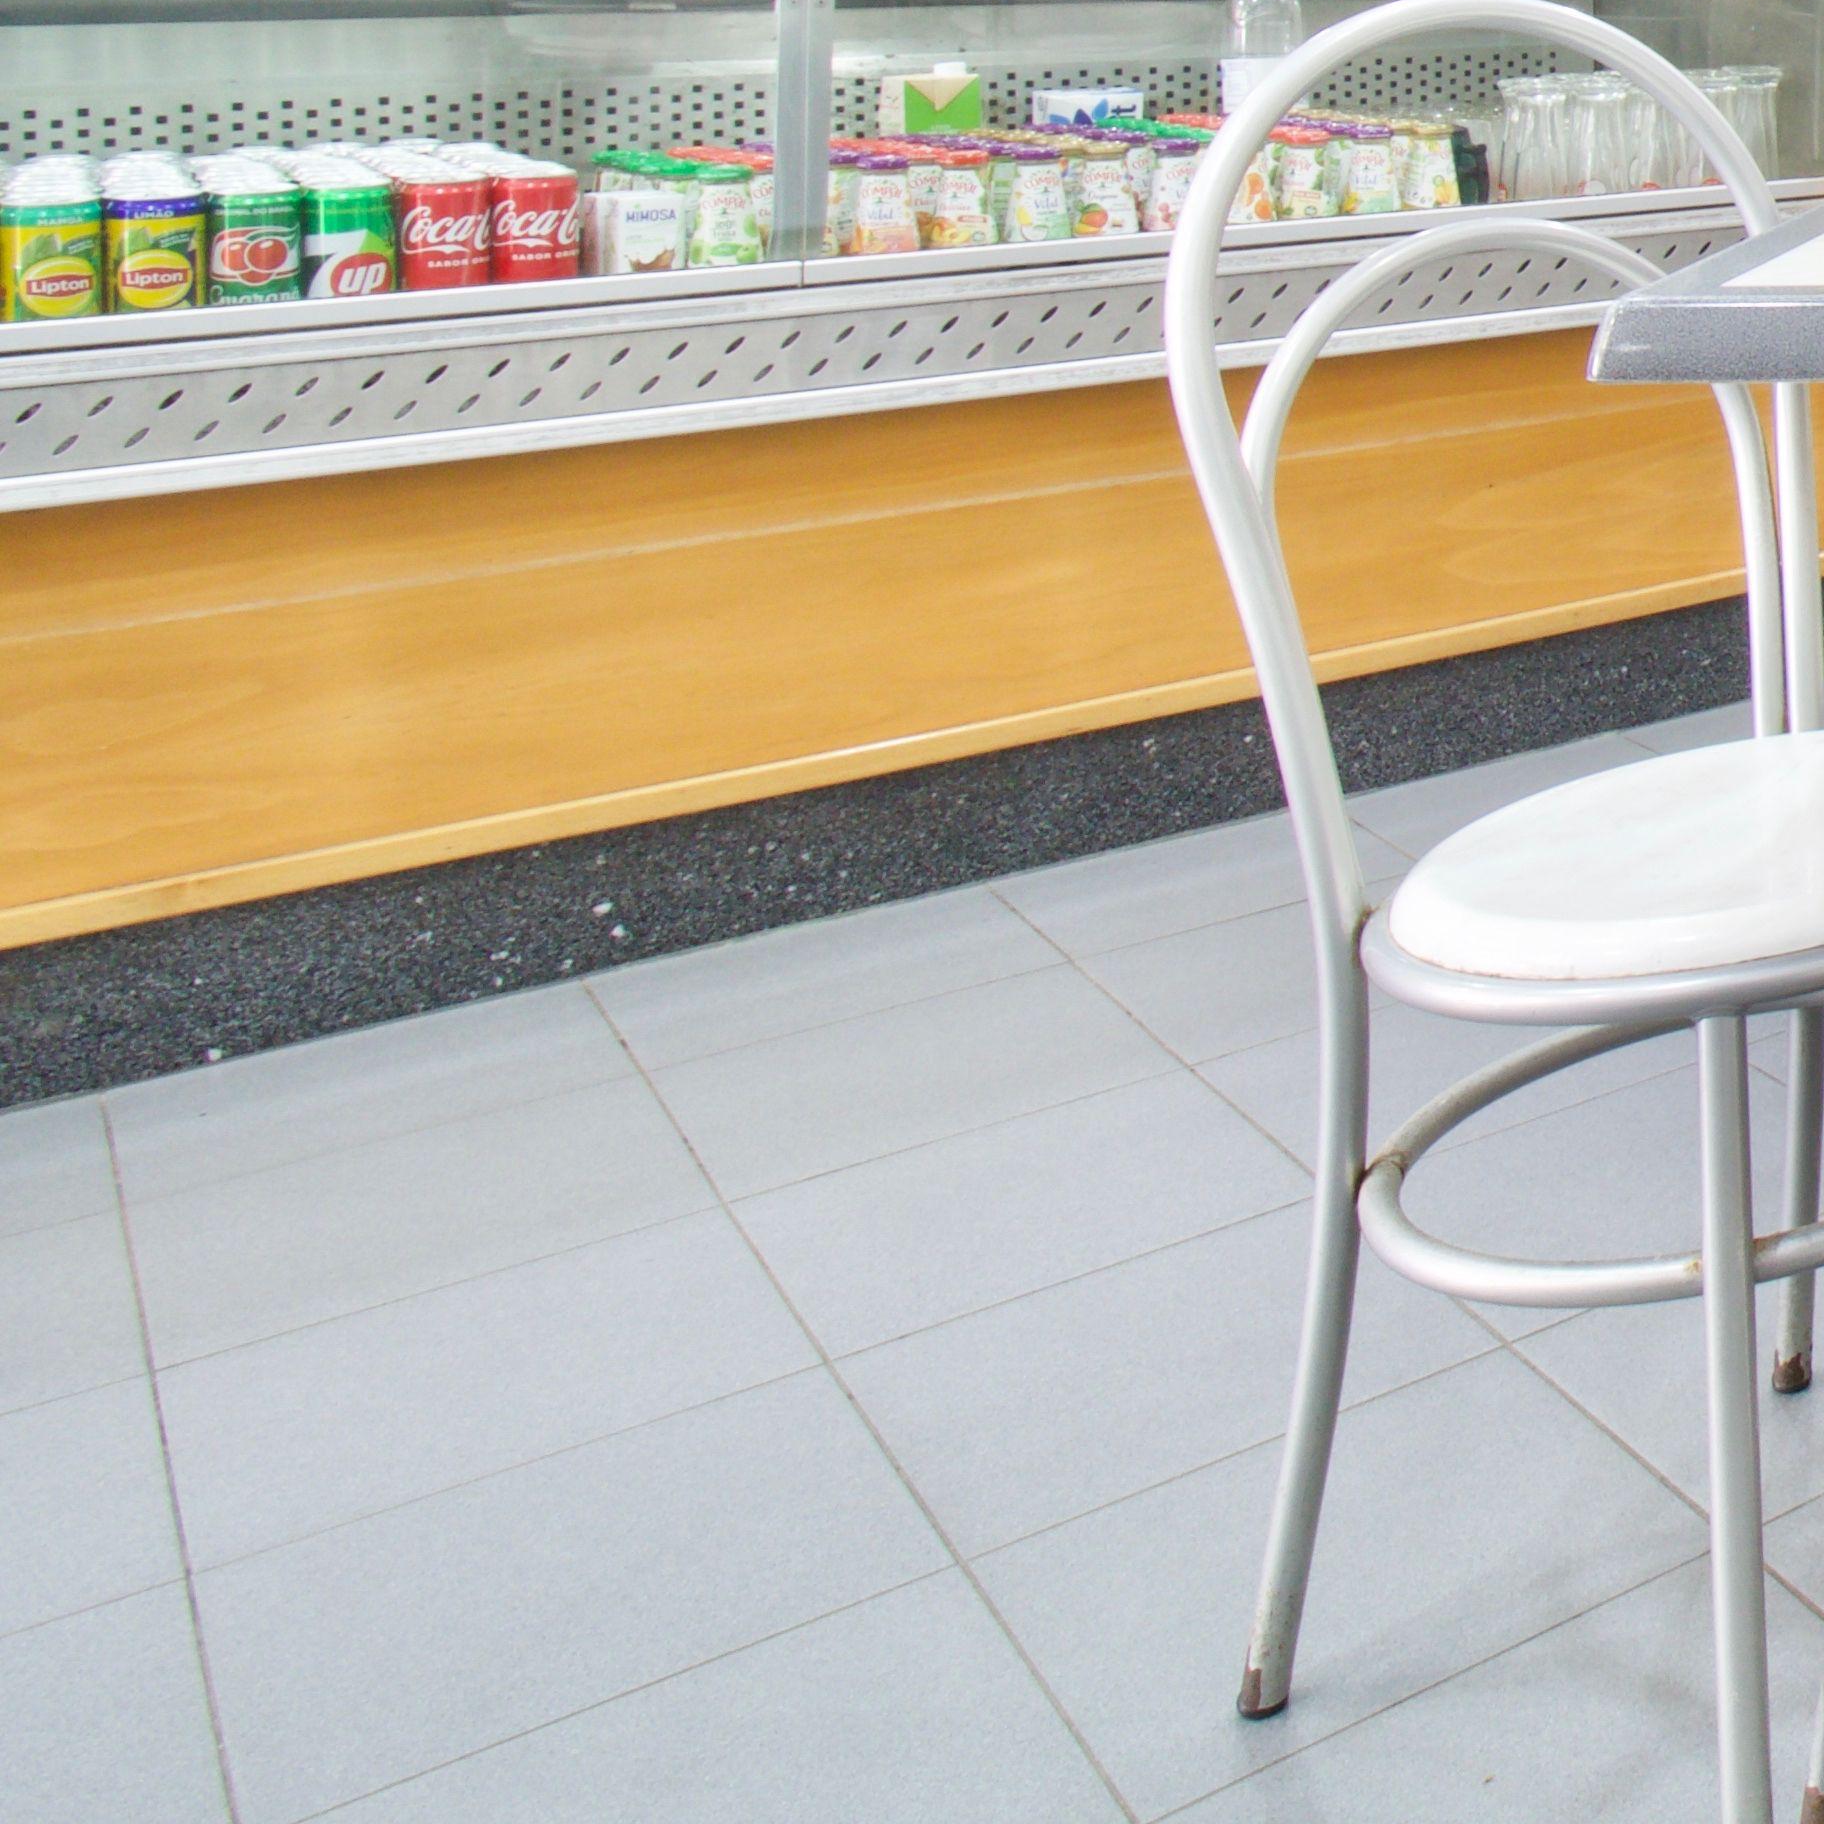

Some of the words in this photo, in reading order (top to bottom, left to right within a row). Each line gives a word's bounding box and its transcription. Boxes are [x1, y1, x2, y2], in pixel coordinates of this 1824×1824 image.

[134, 209, 174, 219] LIMÃO
[625, 208, 677, 224] MIMOSA
[512, 252, 551, 261] SABOR
[30, 278, 90, 294] Lipton
[125, 270, 184, 287] Lipton
